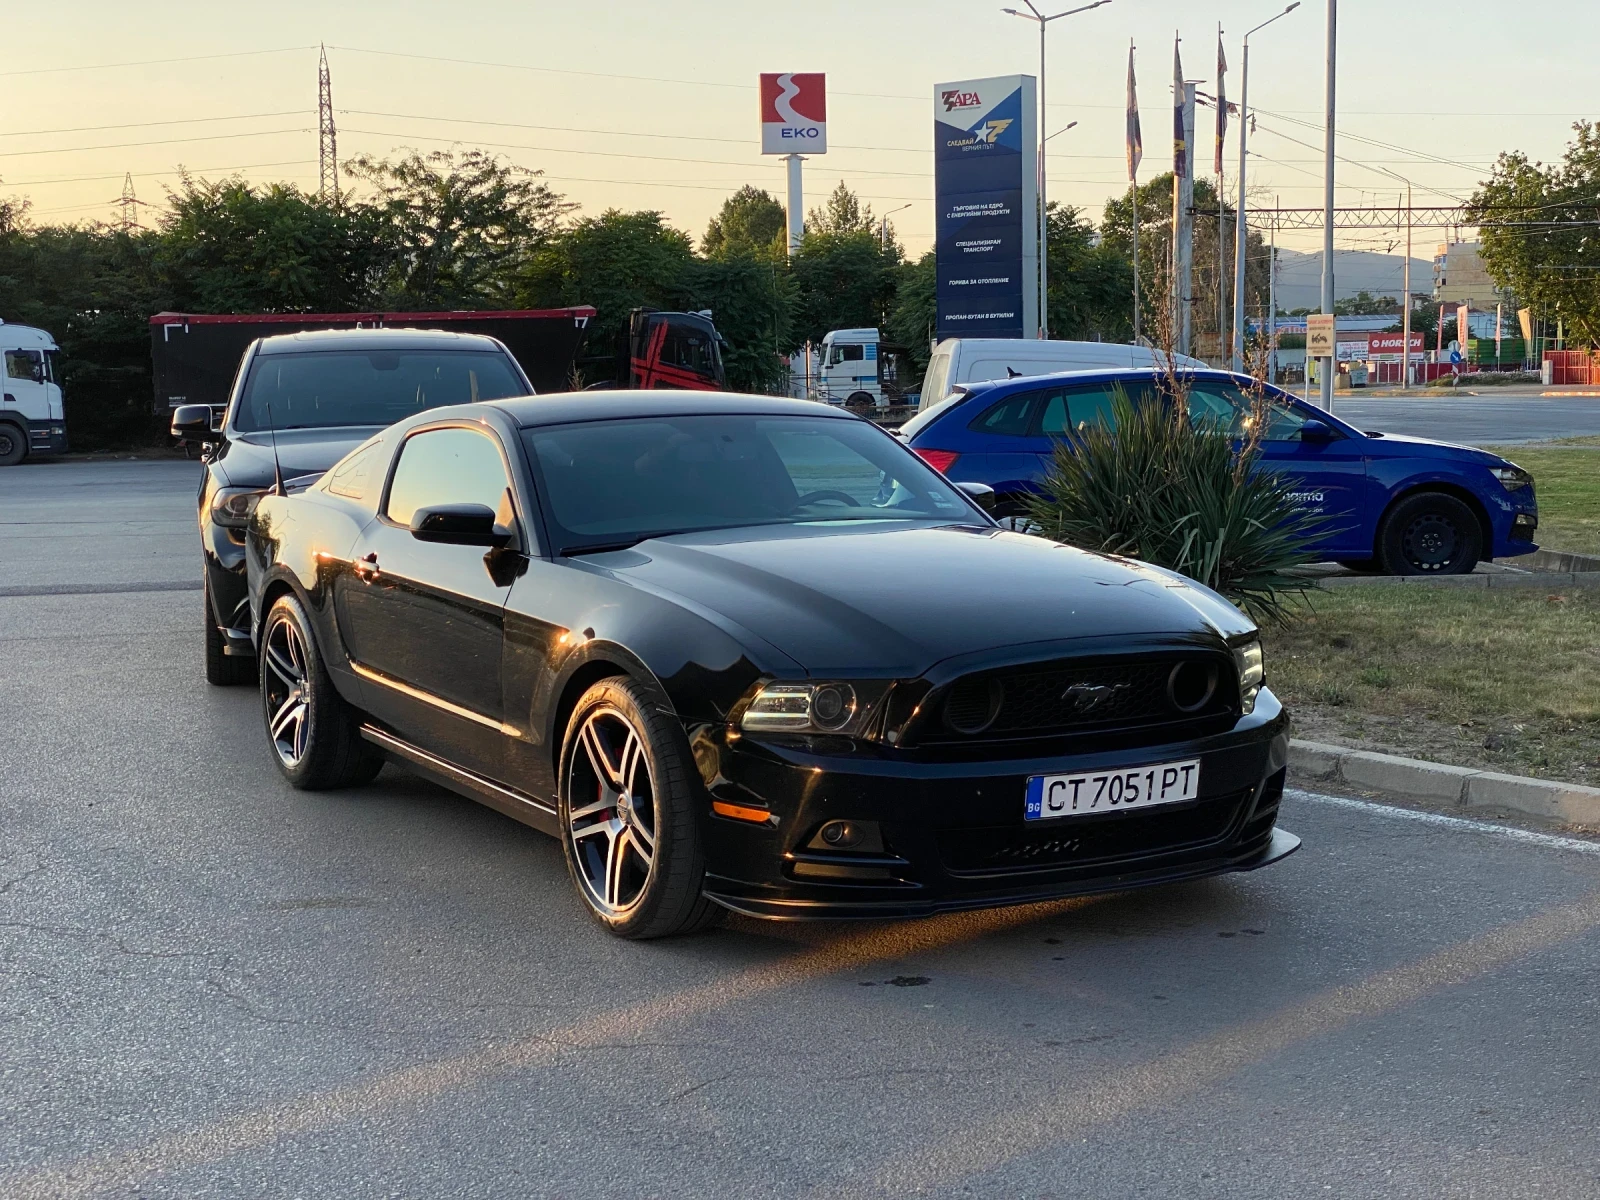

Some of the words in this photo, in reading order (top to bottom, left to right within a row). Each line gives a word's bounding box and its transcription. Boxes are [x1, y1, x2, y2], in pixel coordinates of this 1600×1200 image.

[781, 127, 819, 138] EKO
[947, 138, 974, 147] СЛЕДВАЙ
[953, 204, 980, 212] ТЪРГОВИЯ
[955, 239, 1002, 247] СПЕЦИАЛИЗИРАН
[1027, 802, 1040, 813] BG
